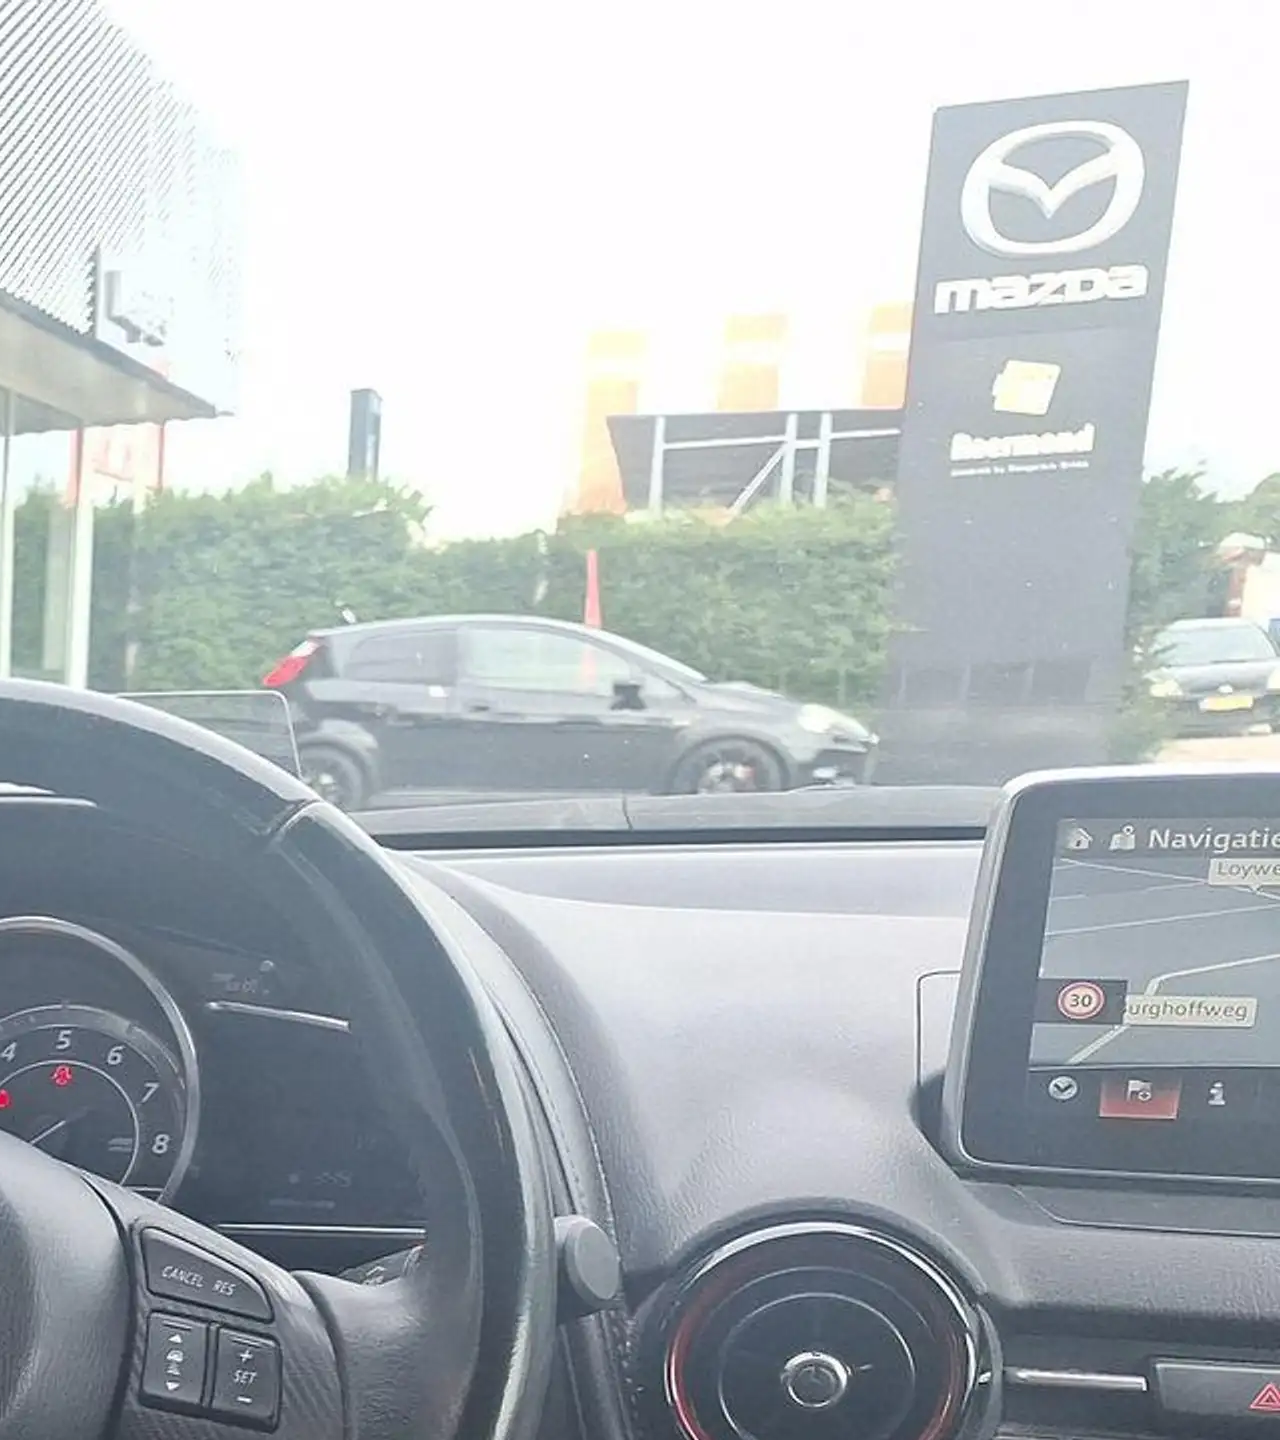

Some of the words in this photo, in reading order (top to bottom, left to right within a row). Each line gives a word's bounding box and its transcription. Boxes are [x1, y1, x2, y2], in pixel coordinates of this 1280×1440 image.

[934, 264, 1149, 314] mazda
[1148, 826, 1280, 854] Navigatie
[1070, 994, 1092, 1009] 30
[1127, 1001, 1248, 1021] urghoffweg
[56, 1030, 71, 1050] 5
[0, 1042, 17, 1062] 4
[107, 1046, 124, 1065] 6
[142, 1083, 159, 1102] 7
[152, 1135, 169, 1154] 8
[161, 1266, 204, 1288] CANCEL
[213, 1279, 236, 1296] RES
[232, 1370, 257, 1386] SET
